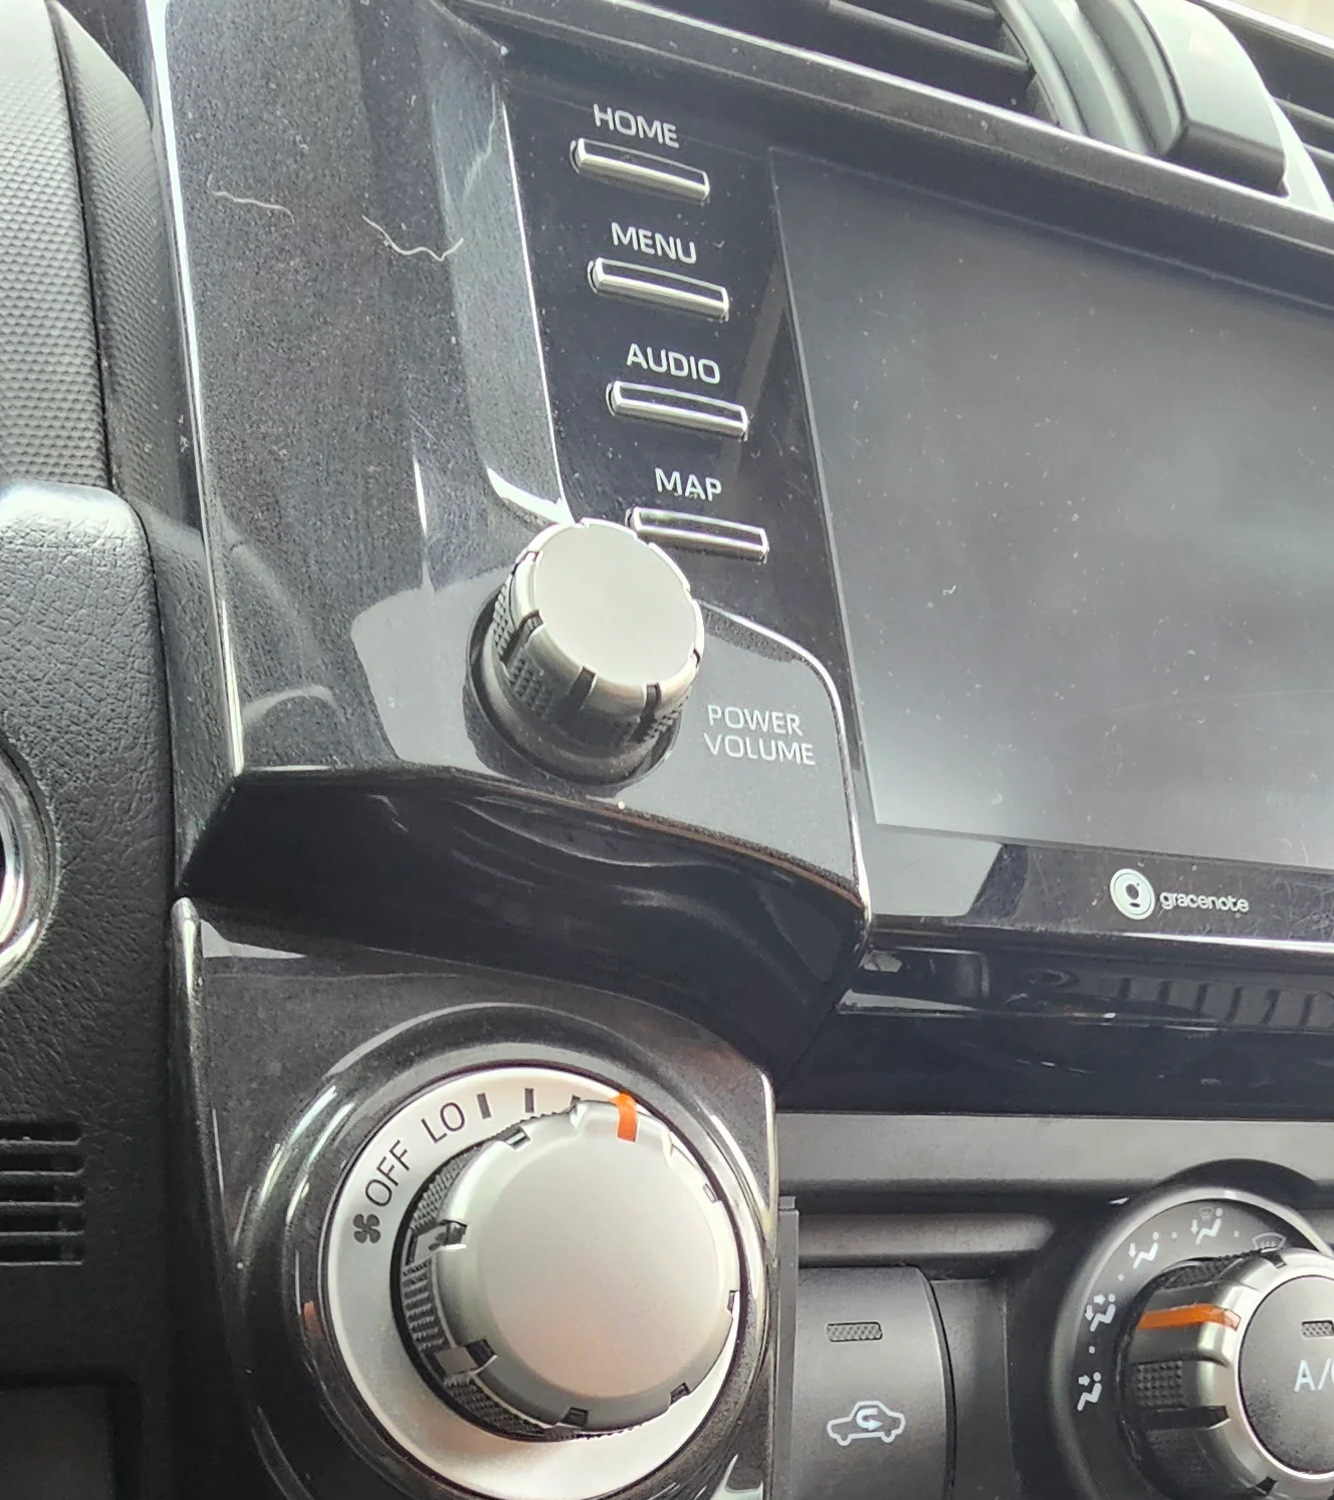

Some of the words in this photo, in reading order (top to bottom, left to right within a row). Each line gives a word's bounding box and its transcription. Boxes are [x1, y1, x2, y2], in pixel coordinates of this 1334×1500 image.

[593, 103, 680, 149] HOME
[610, 222, 698, 265] MENU
[625, 343, 721, 385] AUDIO
[654, 468, 723, 501] MAP
[707, 704, 804, 737] POWER
[703, 732, 816, 766] VOLUME
[1158, 890, 1250, 914] gracenote
[365, 1139, 411, 1208] OFF
[420, 1101, 466, 1144] LO
